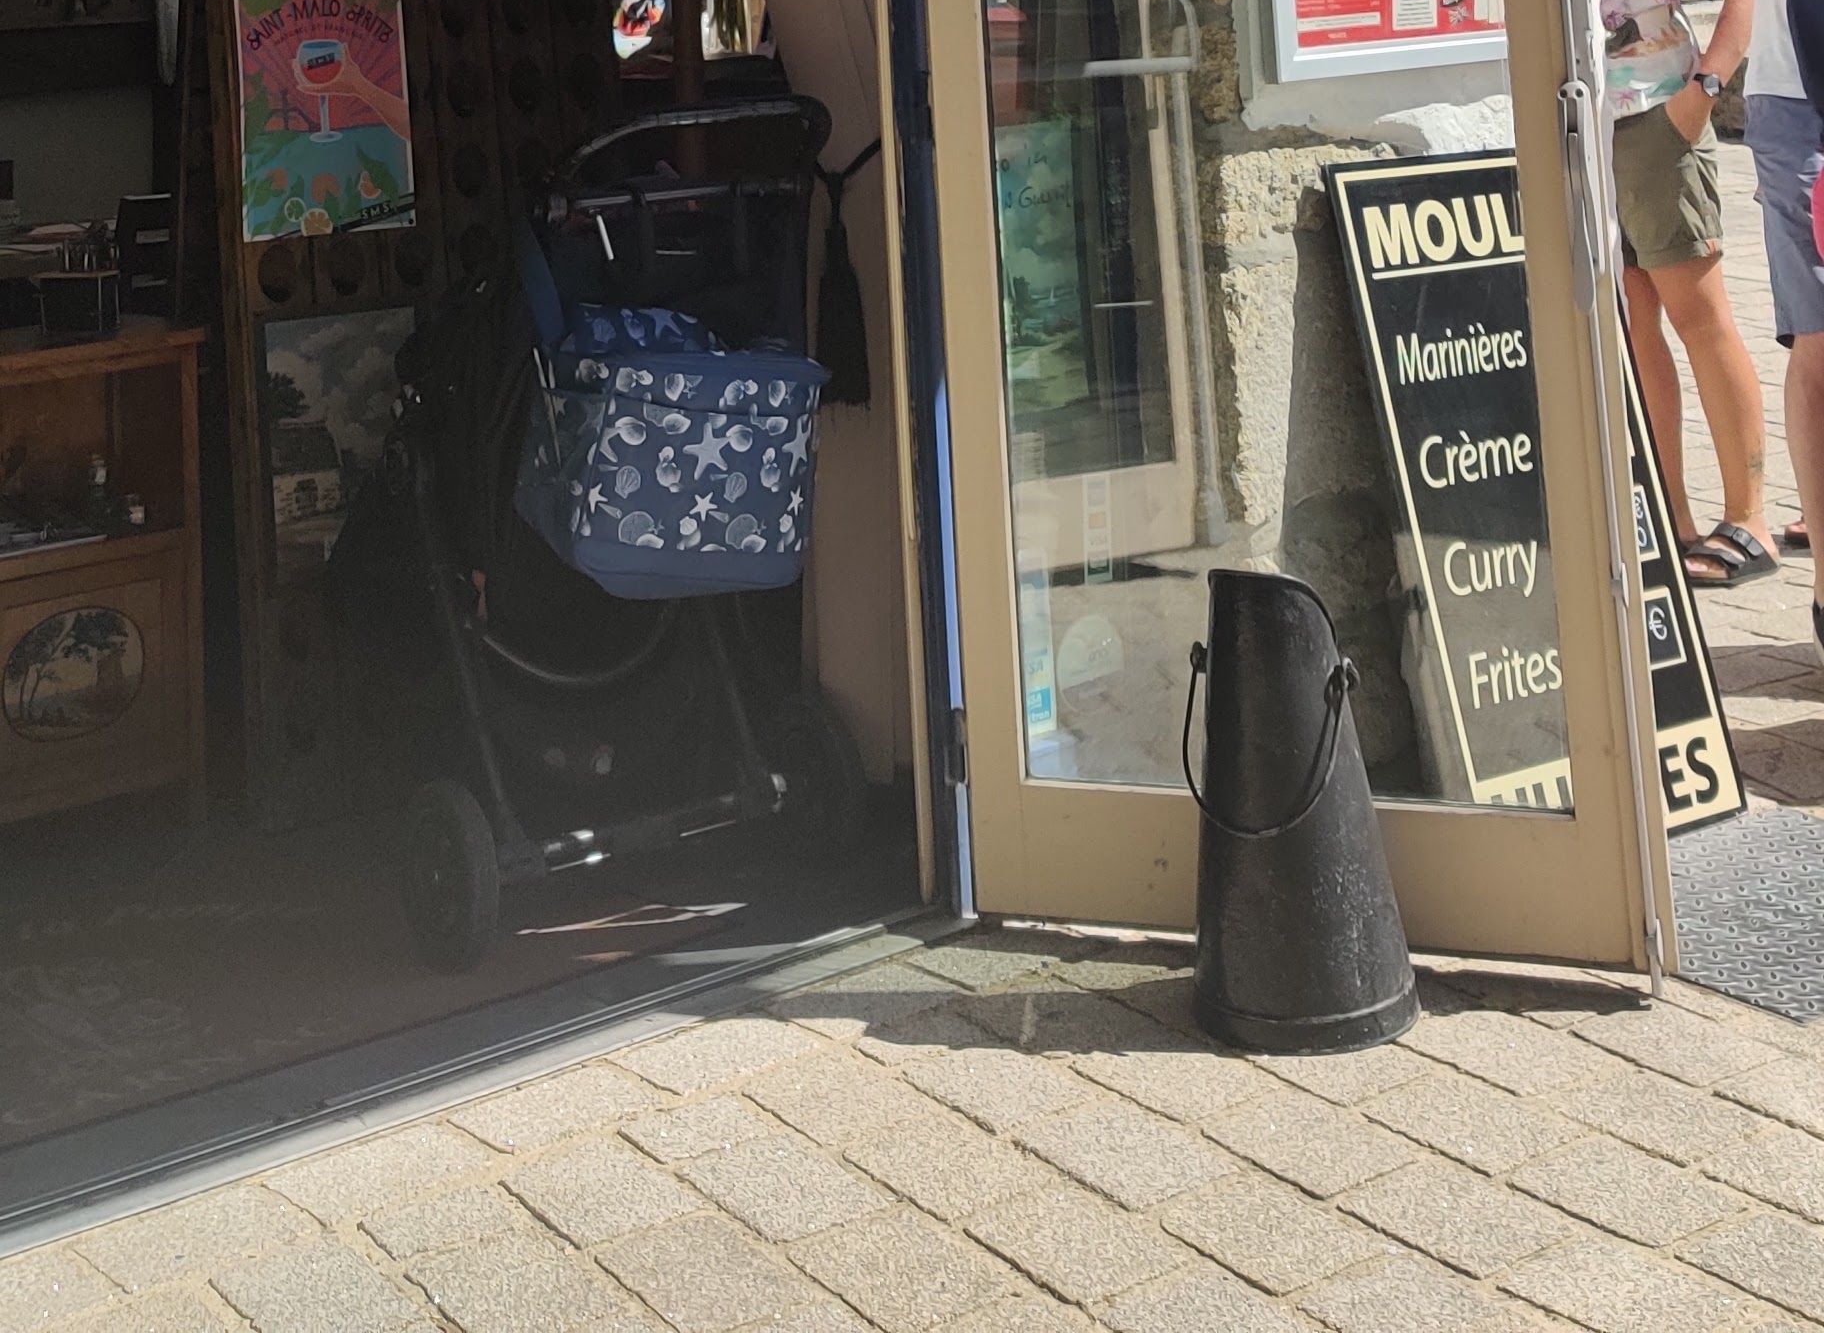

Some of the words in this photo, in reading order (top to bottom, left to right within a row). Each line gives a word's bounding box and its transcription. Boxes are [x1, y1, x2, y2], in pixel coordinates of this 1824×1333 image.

[1396, 322, 1528, 386] Marinières
[1419, 429, 1534, 489] Crème
[1443, 538, 1538, 598] Curry
[1468, 644, 1564, 710] Frites
